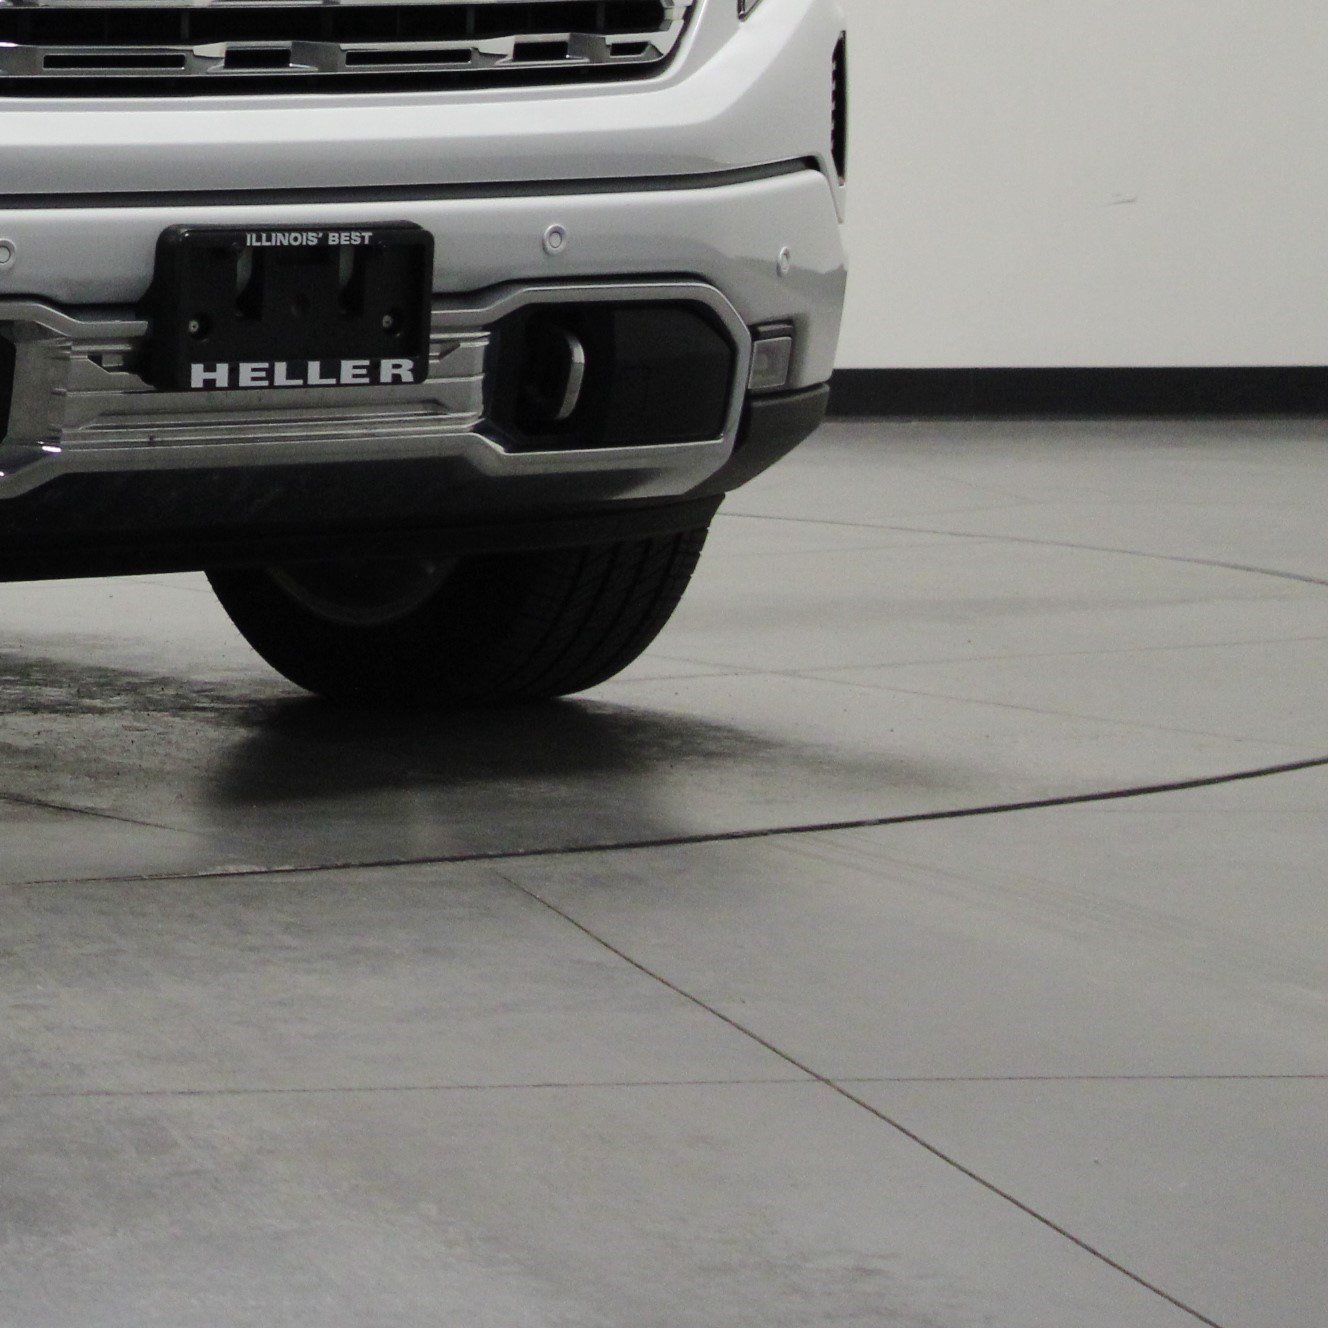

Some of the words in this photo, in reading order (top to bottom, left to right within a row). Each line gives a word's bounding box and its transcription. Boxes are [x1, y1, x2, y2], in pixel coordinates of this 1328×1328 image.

[245, 231, 324, 247] ILLINOIS'
[328, 231, 373, 246] BEST
[190, 357, 415, 389] HELLER
